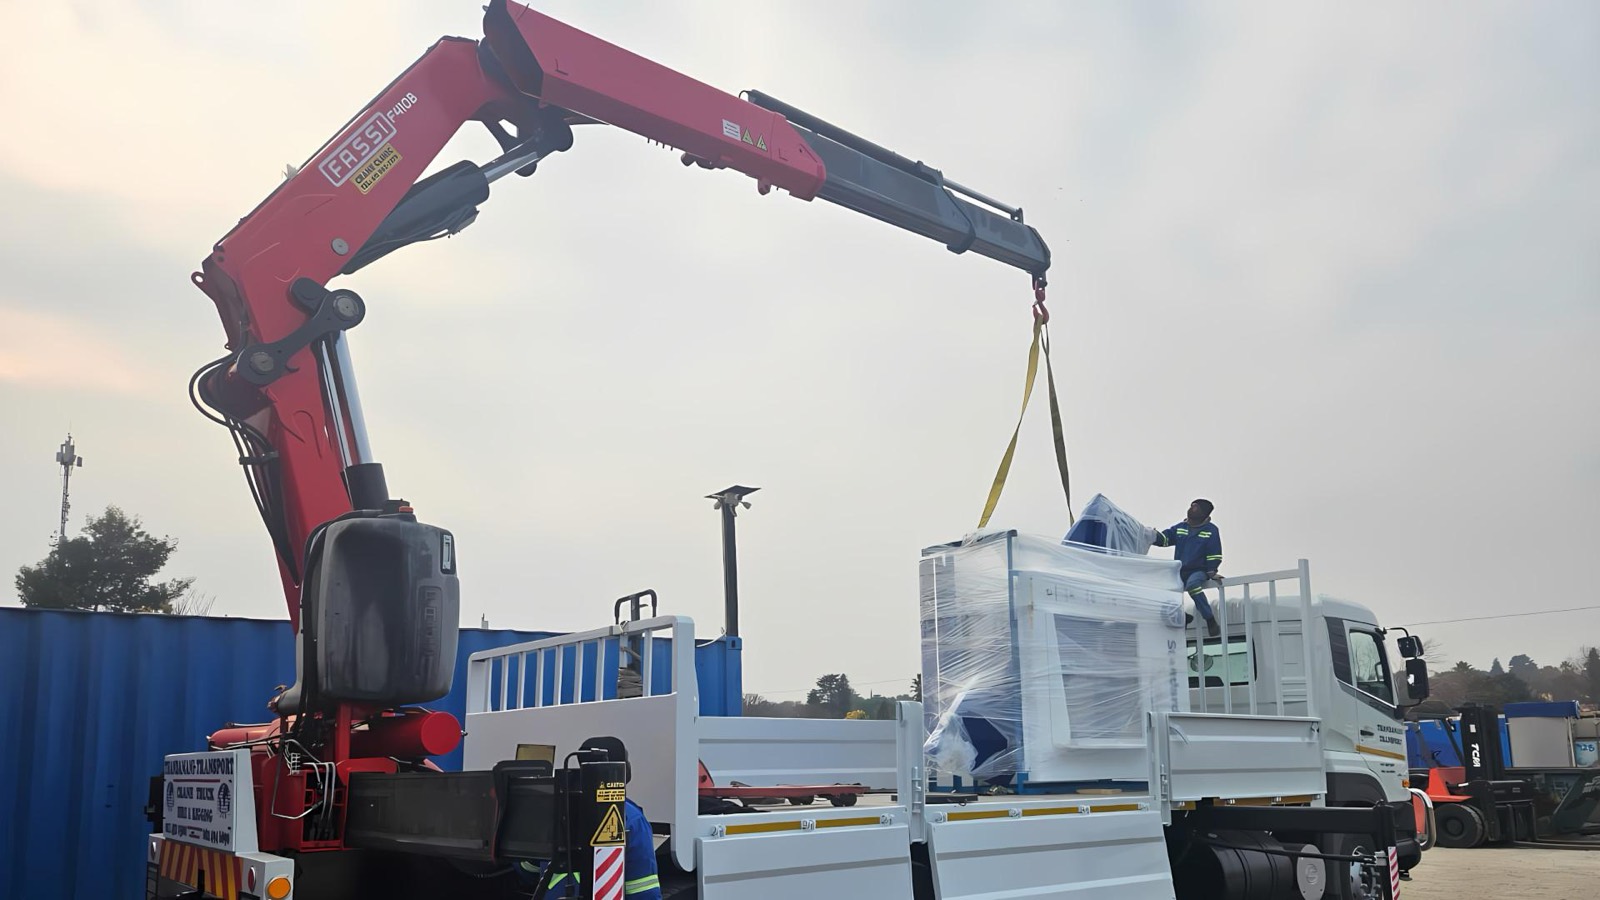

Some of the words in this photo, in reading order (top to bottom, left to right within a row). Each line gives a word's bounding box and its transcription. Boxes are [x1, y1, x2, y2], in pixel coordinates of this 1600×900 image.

[386, 92, 418, 123] F410B
[327, 120, 389, 178] FASSI
[196, 757, 234, 775] TRANSPORT
[1471, 742, 1480, 767] TCM
[177, 786, 194, 799] CRANE
[196, 787, 215, 801] TRUCK
